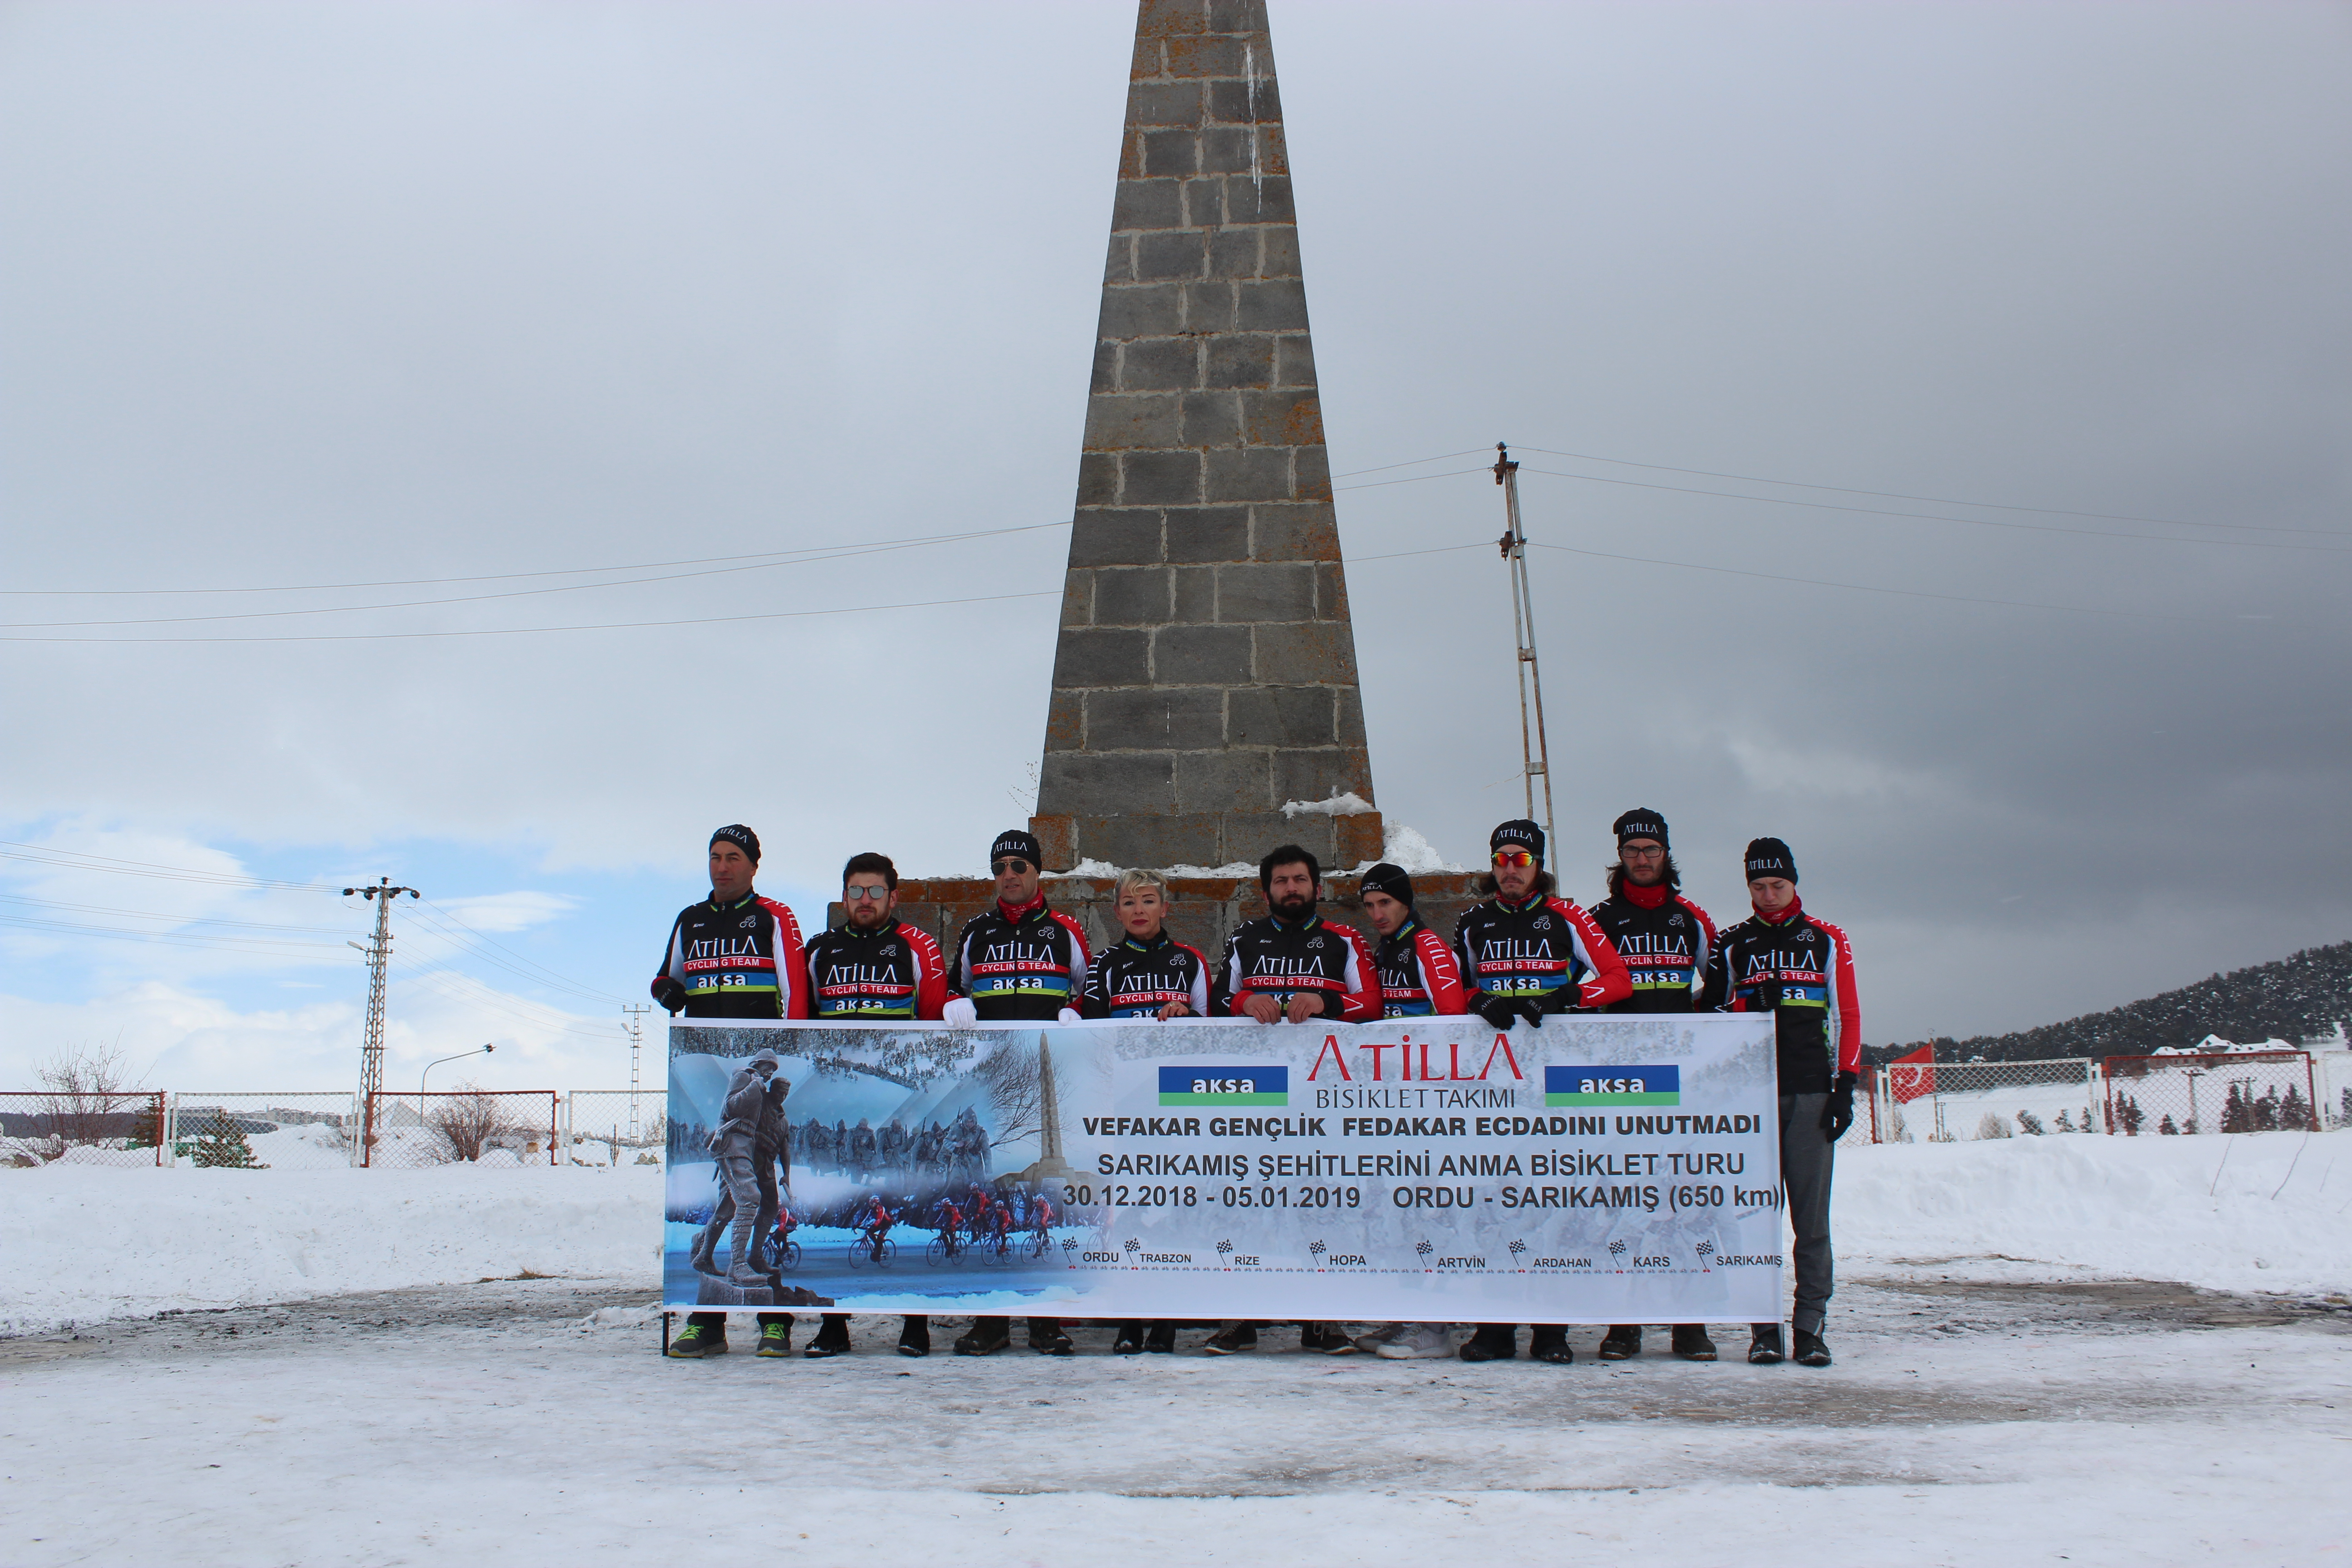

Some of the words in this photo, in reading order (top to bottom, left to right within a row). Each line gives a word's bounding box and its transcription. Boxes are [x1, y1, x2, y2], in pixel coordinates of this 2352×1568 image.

[1623, 822, 1658, 835] ATİLLA
[1496, 828, 1533, 843] ATİLLA
[994, 841, 1028, 854] ATİLLA
[688, 936, 759, 959] ATİLLA
[1481, 938, 1553, 960] ATİLLA
[1617, 932, 1688, 955] ATİLLA
[985, 941, 1054, 963] ATİLLA
[688, 958, 728, 970] CYCLING
[982, 963, 1025, 972] CYCLING
[1252, 955, 1324, 975] ATİLLA
[1418, 934, 1457, 990] ATİLLA
[1481, 961, 1522, 971] CYCLING
[1525, 961, 1553, 970] TEAM
[1747, 949, 1817, 975] ATİLLA
[825, 963, 897, 985] ATİLLA
[1632, 972, 1680, 984] aksa
[698, 975, 746, 988] aksa
[993, 978, 1043, 990] aksa
[1119, 971, 1186, 992] ATİLLA
[1252, 977, 1294, 986] CYCLING
[1298, 978, 1324, 987] TEAM
[1492, 978, 1541, 991] aksa
[826, 985, 867, 995] CYCLING
[870, 985, 897, 994] TEAM
[1119, 993, 1162, 1004] CYCLING
[1166, 993, 1188, 1002] TEAM
[836, 1000, 884, 1011] aksa
[1307, 1034, 1524, 1081] ATİLLA
[1192, 1078, 1254, 1093] aksa
[1580, 1078, 1645, 1093] aksa
[1316, 1084, 1428, 1109] BİSİKLET
[1434, 1088, 1515, 1108] TAKIMI
[1083, 1117, 1200, 1136] VEFAKAR
[1210, 1112, 1326, 1141] GENÇLİK
[1343, 1116, 1466, 1137] FEDAKAR
[1475, 1116, 1606, 1136] ECDADINI
[1616, 1115, 1760, 1135] UNUTMADI
[1098, 1154, 1249, 1181] SARIKAMIŞ
[1258, 1149, 1430, 1181] ŞEHİTLERİNİ
[1438, 1155, 1523, 1176] ANMA
[1531, 1149, 1659, 1176] BİSİKLET
[1667, 1153, 1744, 1175] TURU
[1063, 1186, 1197, 1207] 30.12.2018
[1222, 1186, 1360, 1208] 05.01.2019
[1393, 1186, 1473, 1209] ORDU
[1501, 1186, 1660, 1213] SARIKAMIŞ
[1669, 1185, 1724, 1213] (650
[1734, 1184, 1780, 1213] km)
[1083, 1252, 1119, 1263] ORDU
[1140, 1253, 1191, 1264] TRABZON
[1235, 1254, 1260, 1266] RİZE
[1329, 1254, 1367, 1266] HOPA
[1437, 1255, 1485, 1268] ARTVİN
[1533, 1258, 1592, 1268] ARDAHAN
[1633, 1256, 1671, 1268] KARS
[1716, 1255, 1783, 1267] SARIKAMIŞ
